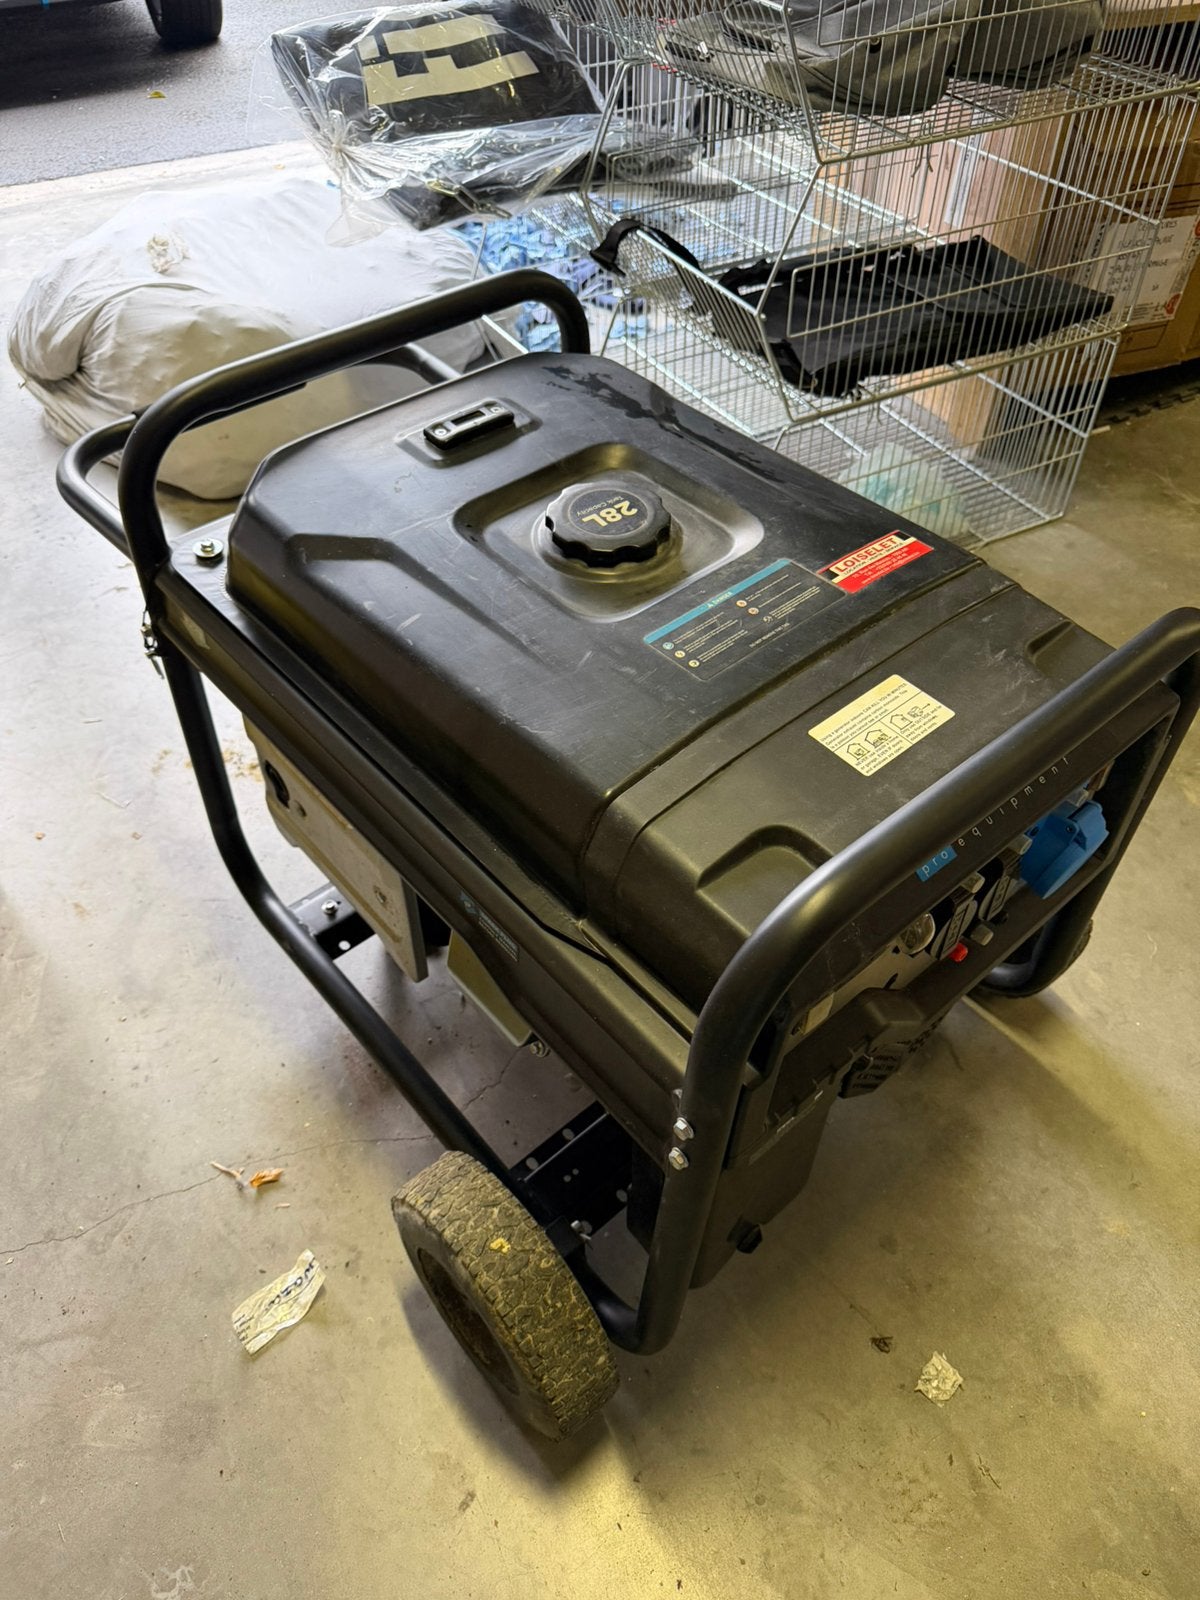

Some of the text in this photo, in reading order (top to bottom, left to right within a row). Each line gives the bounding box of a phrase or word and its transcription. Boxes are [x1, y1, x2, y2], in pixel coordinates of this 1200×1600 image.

[581, 500, 638, 527] 28L
[835, 537, 898, 573] LOISELET
[921, 756, 1069, 877] pro equipment
